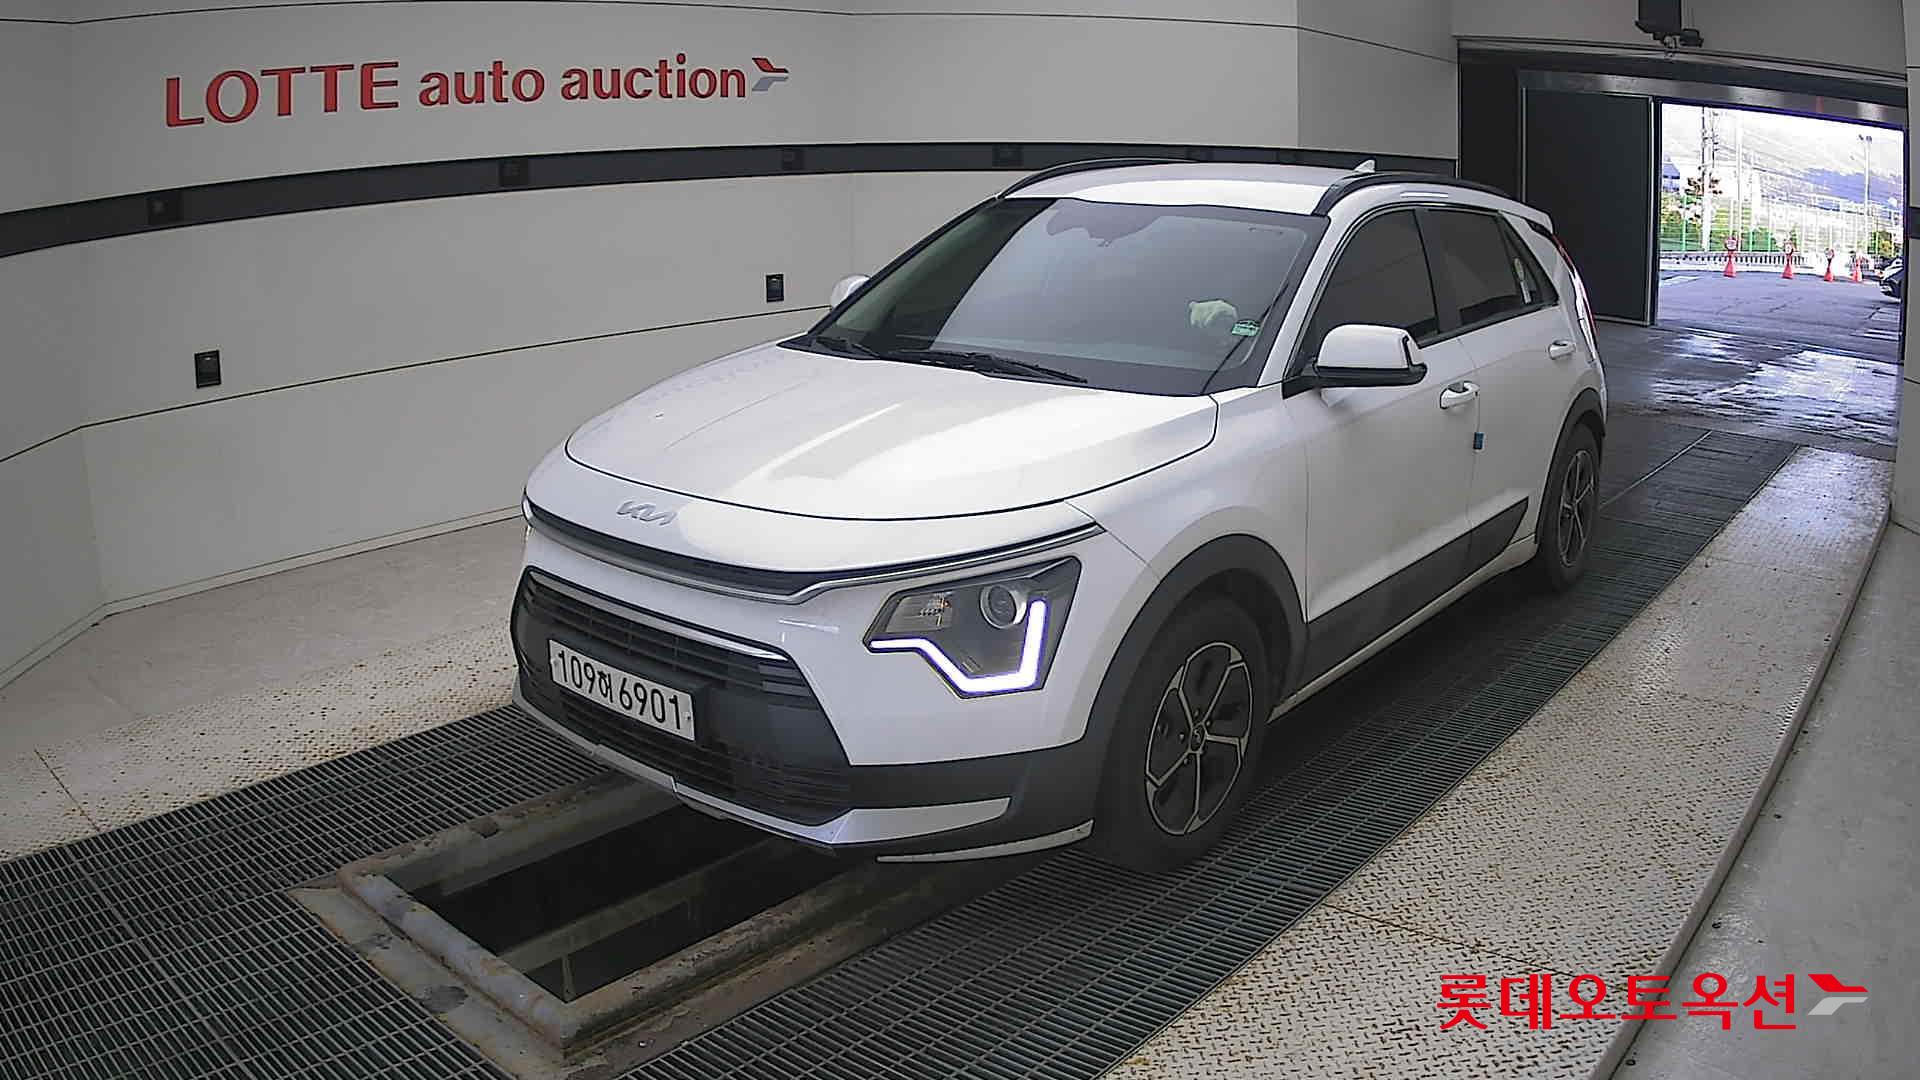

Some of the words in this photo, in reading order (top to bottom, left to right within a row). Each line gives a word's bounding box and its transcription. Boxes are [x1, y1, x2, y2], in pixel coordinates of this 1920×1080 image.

[165, 61, 399, 127] LOTTE
[418, 60, 545, 106] auto
[560, 52, 747, 100] auction
